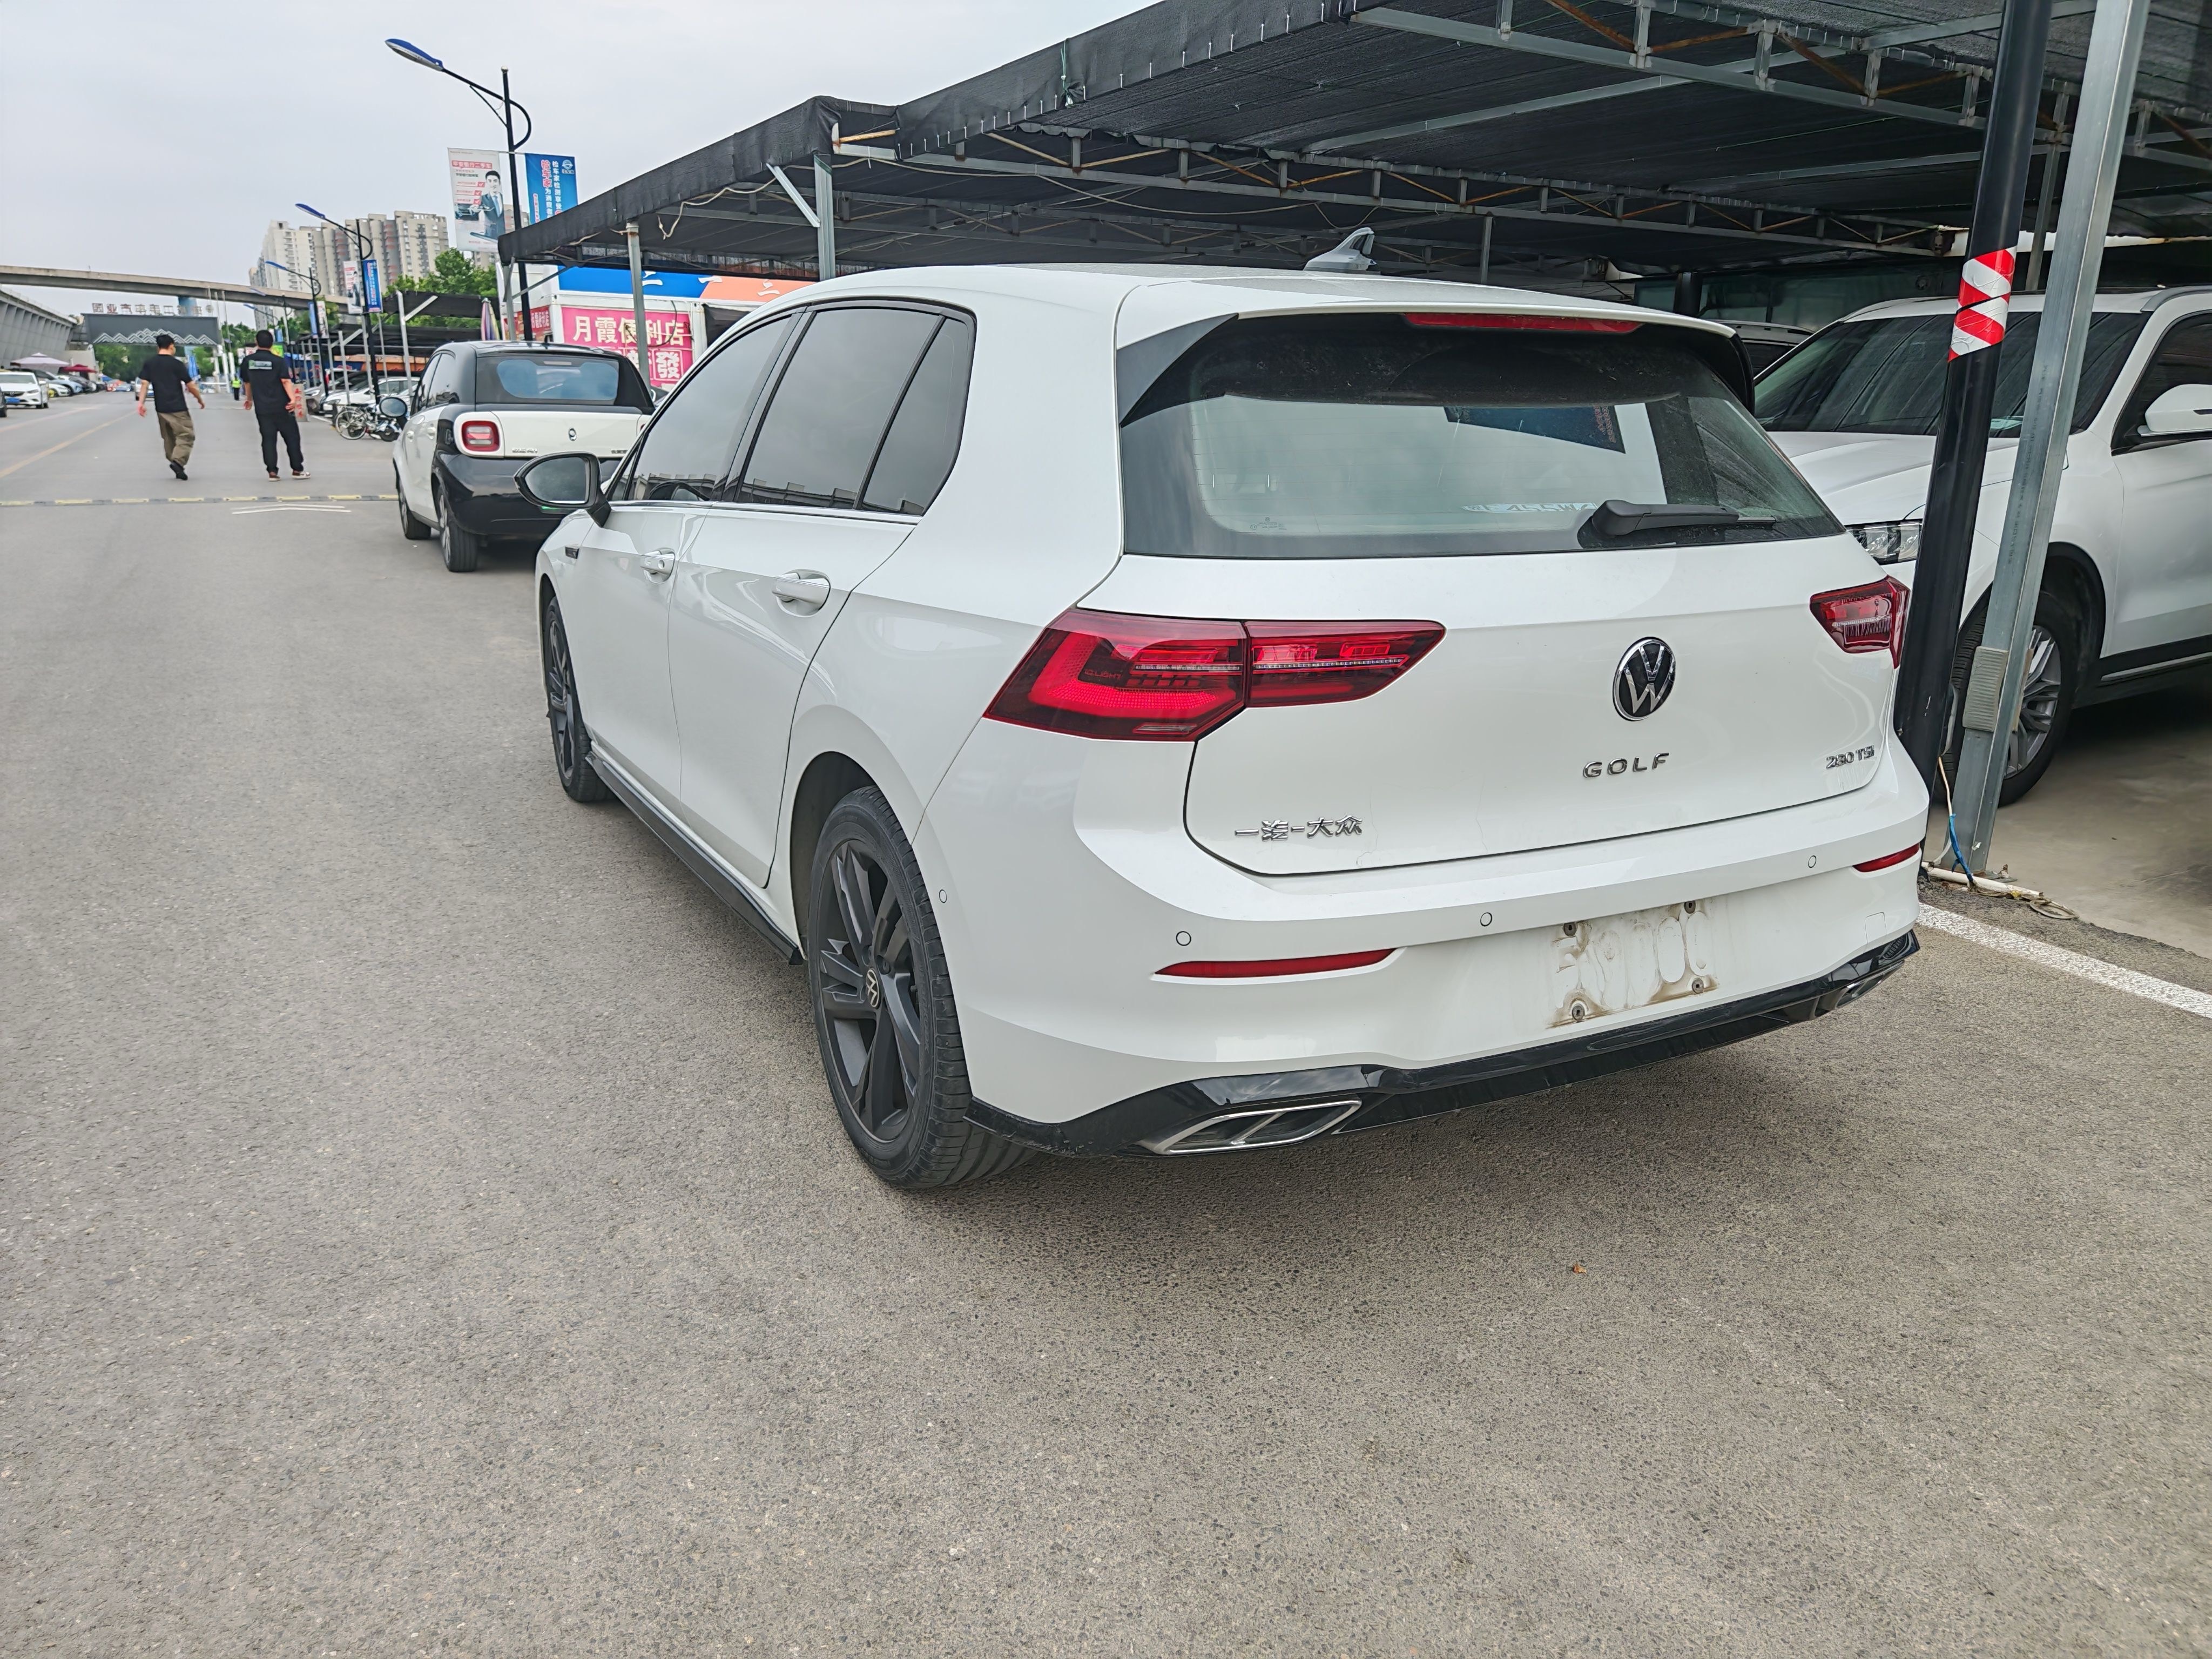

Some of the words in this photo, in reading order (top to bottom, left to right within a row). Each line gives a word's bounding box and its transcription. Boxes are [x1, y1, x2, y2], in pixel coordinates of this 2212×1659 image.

[573, 316, 684, 346] 月霞便利店
[1583, 752, 1669, 779] GOLF
[1826, 752, 1854, 769] 280
[1235, 814, 1363, 841] 一汽-大众
